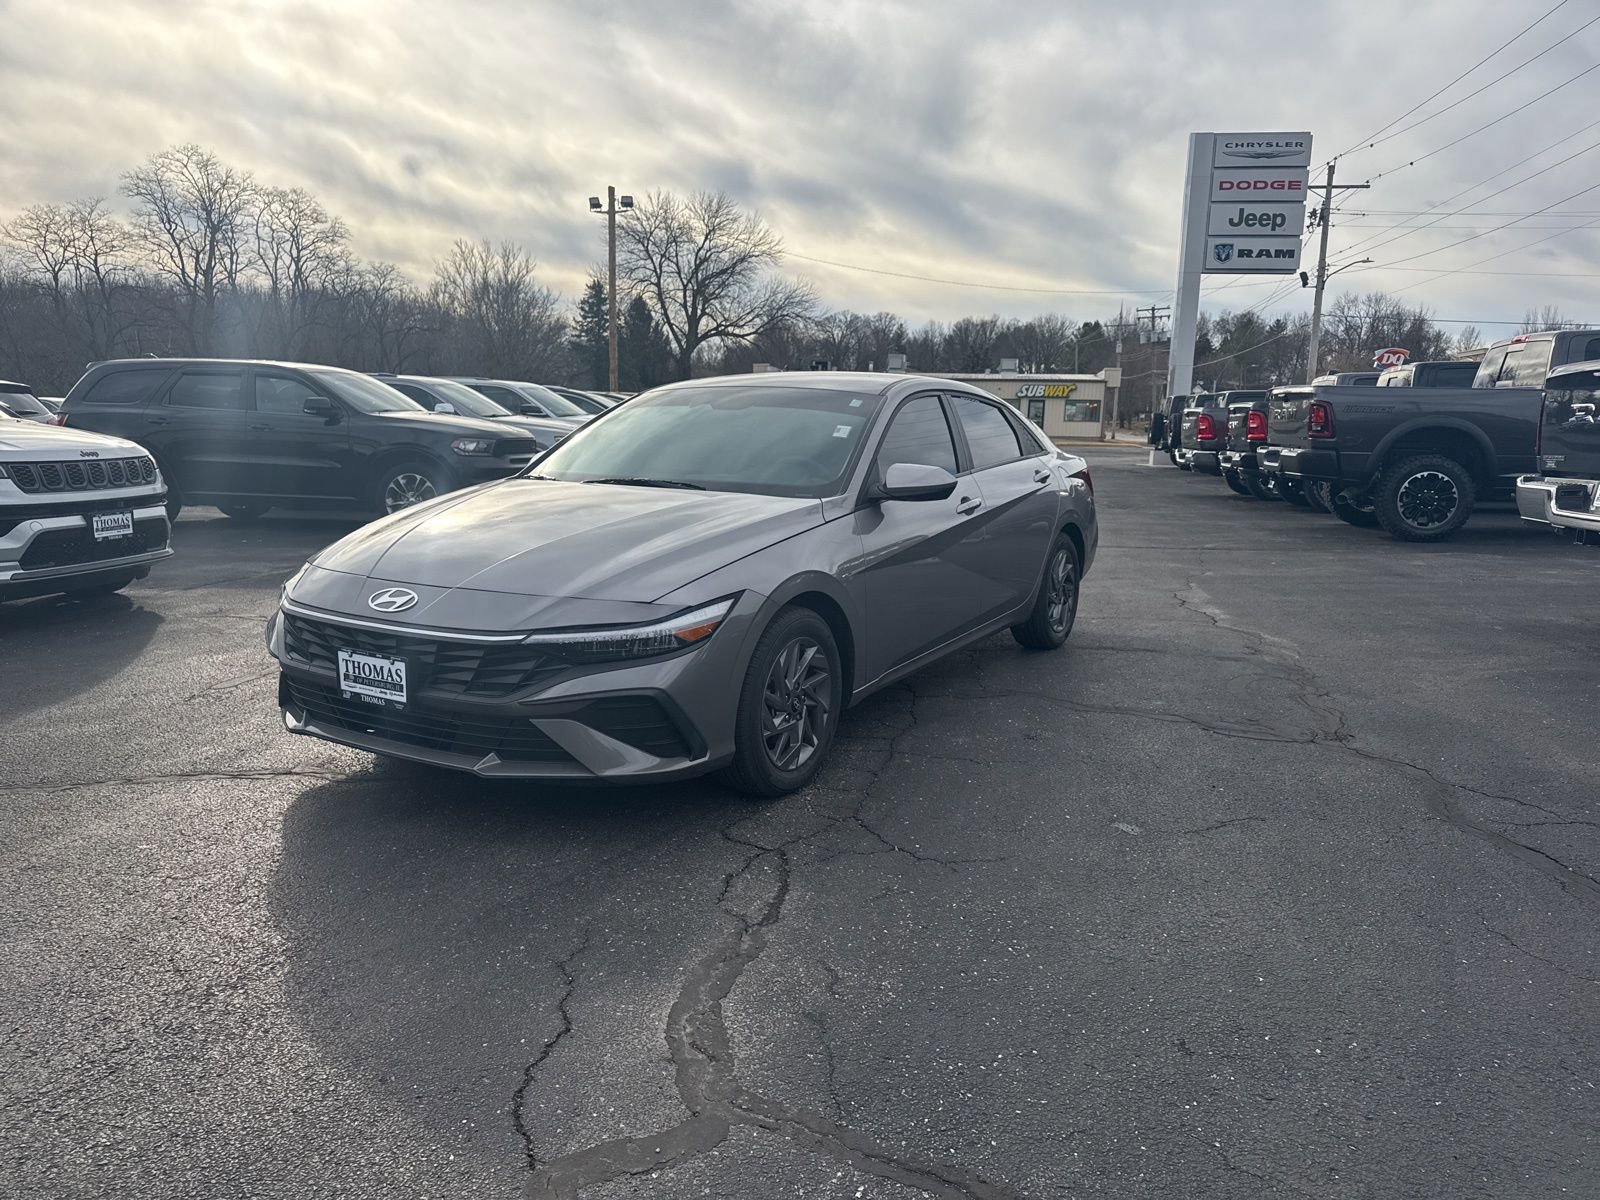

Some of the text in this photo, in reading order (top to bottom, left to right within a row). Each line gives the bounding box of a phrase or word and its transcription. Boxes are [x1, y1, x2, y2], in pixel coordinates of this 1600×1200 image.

[1224, 141, 1304, 149] CHRYSLER
[1218, 180, 1303, 191] DODGE
[1228, 207, 1287, 231] Jeep
[1237, 248, 1296, 259] RAM
[1381, 353, 1404, 366] DQ
[1017, 384, 1077, 398] SUBWAY
[95, 516, 130, 528] THOMAS
[342, 658, 403, 684] THOMAS
[361, 694, 385, 706] THOMAS
